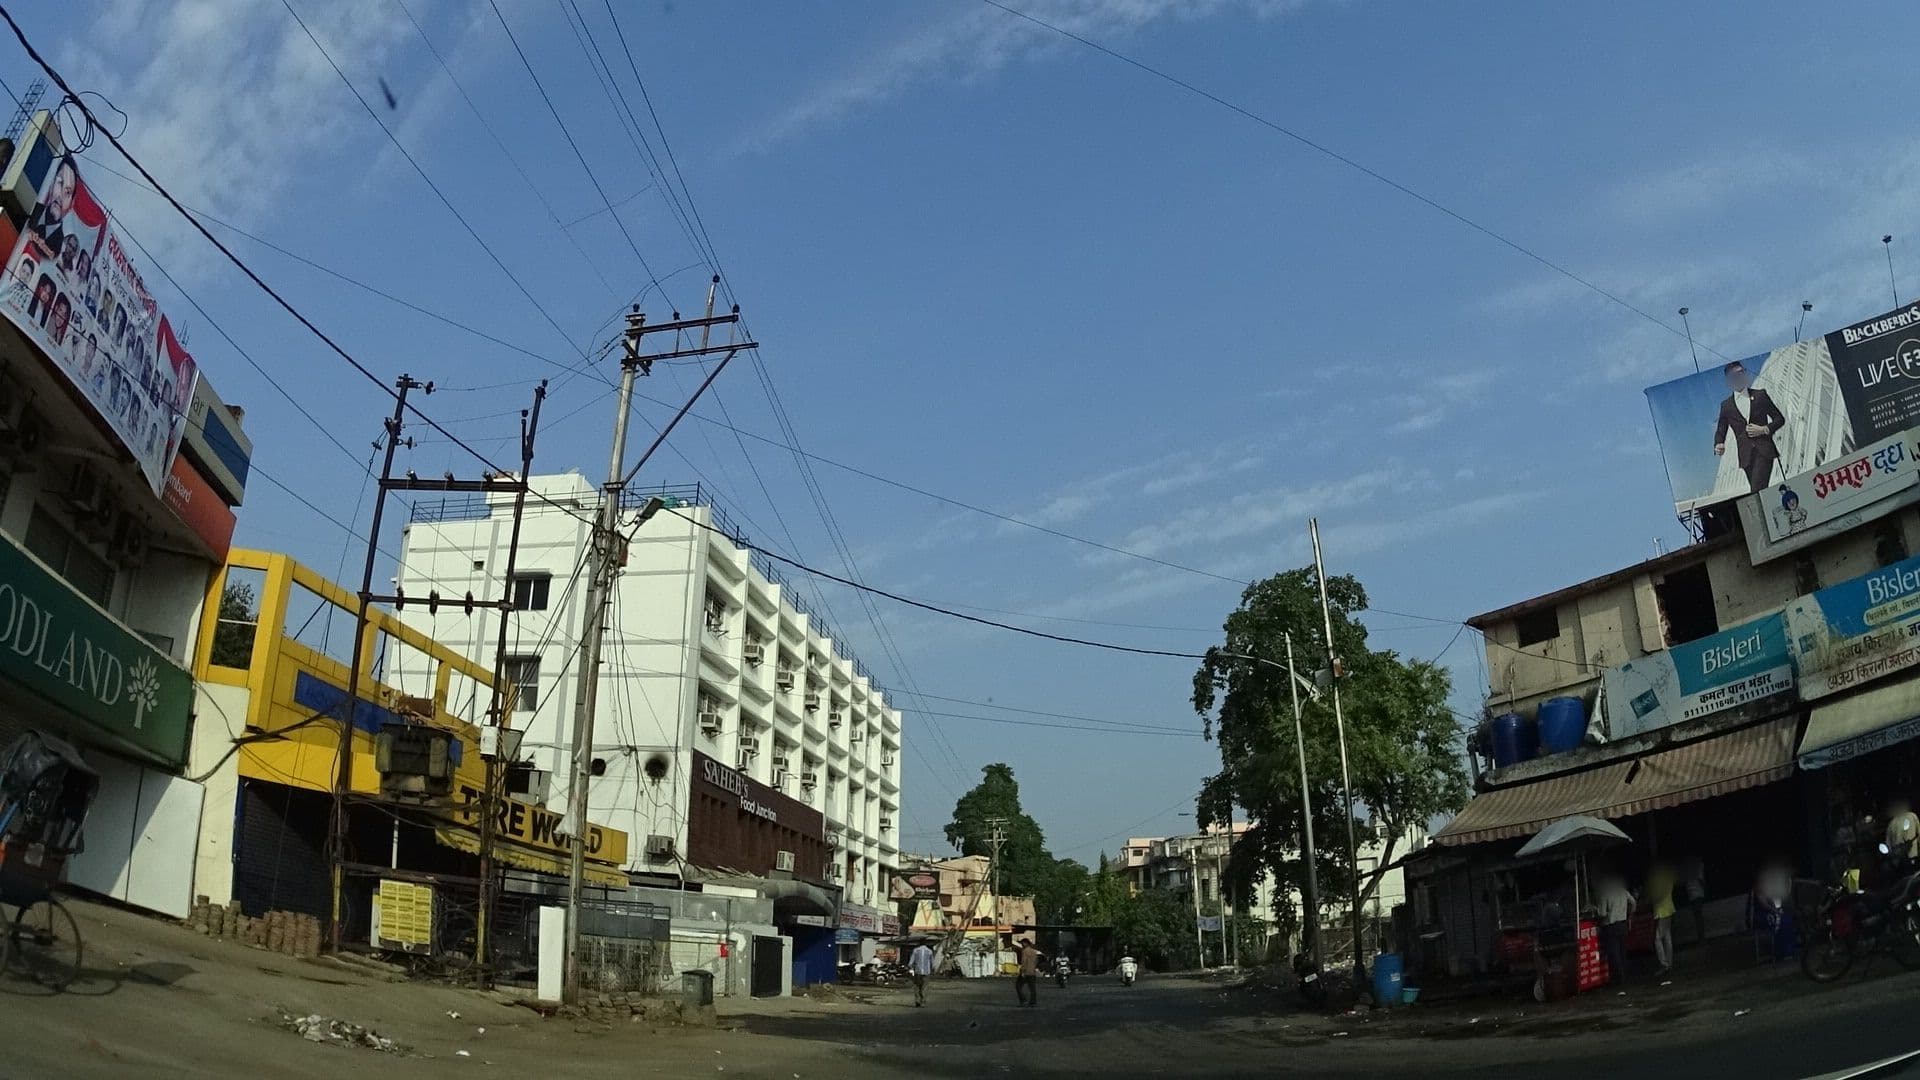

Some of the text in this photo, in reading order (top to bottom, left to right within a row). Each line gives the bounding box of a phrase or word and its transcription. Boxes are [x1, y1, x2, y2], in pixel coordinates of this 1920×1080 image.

[1842, 306, 1920, 344] BLACKBERRYS
[1858, 356, 1900, 388] LIVE
[1812, 456, 1873, 499] अमूल
[1872, 442, 1905, 475] दूध
[1701, 628, 1762, 675] Bisleri
[1699, 673, 1774, 704] कमल पान भंडार
[460, 784, 603, 853] TRE WOD
[740, 796, 777, 822] Food Junction
